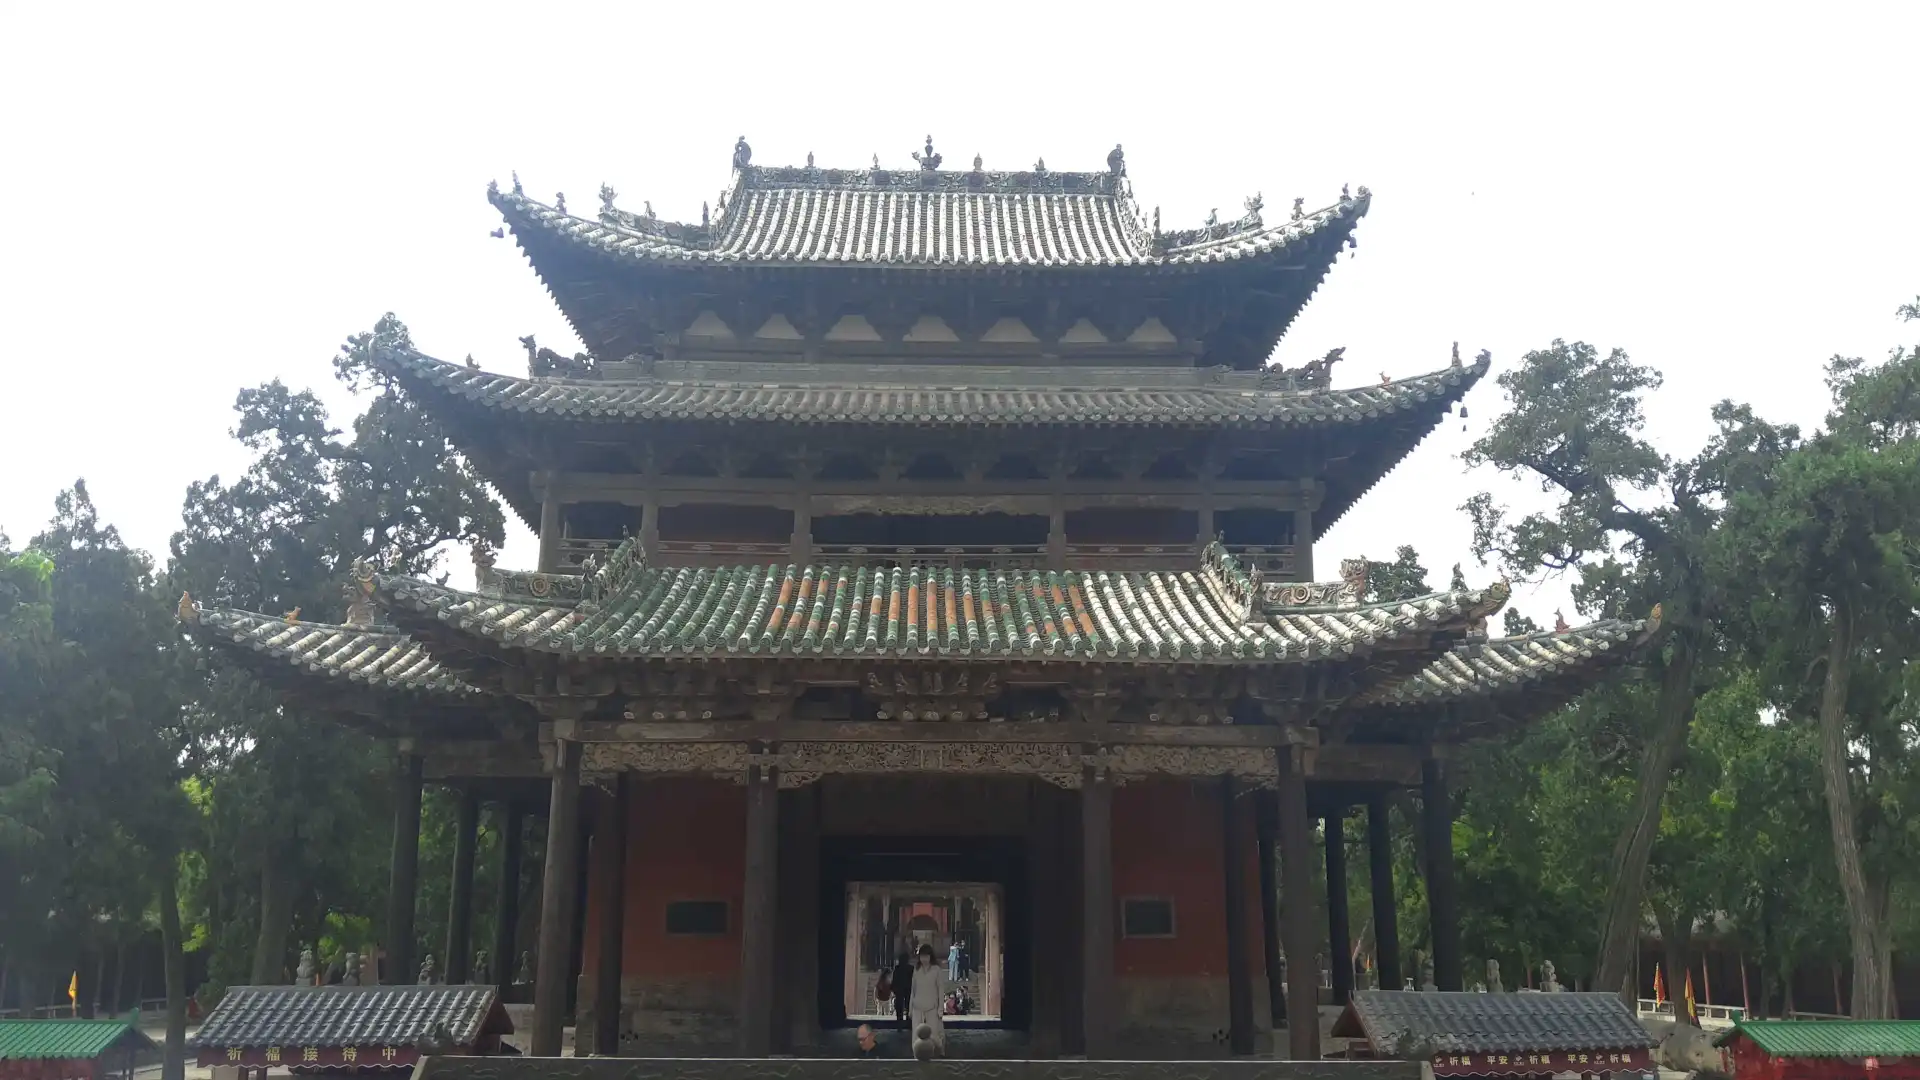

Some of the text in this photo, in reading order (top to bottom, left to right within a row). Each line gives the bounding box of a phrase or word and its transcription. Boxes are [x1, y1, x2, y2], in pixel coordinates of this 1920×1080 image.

[227, 1045, 396, 1061] 祈福接待中
[1449, 1055, 1472, 1067] 祈福
[1487, 1055, 1508, 1065] 平安
[1529, 1055, 1550, 1065] 祈福
[1568, 1054, 1588, 1064] 平安
[1610, 1054, 1631, 1064] 祈福
